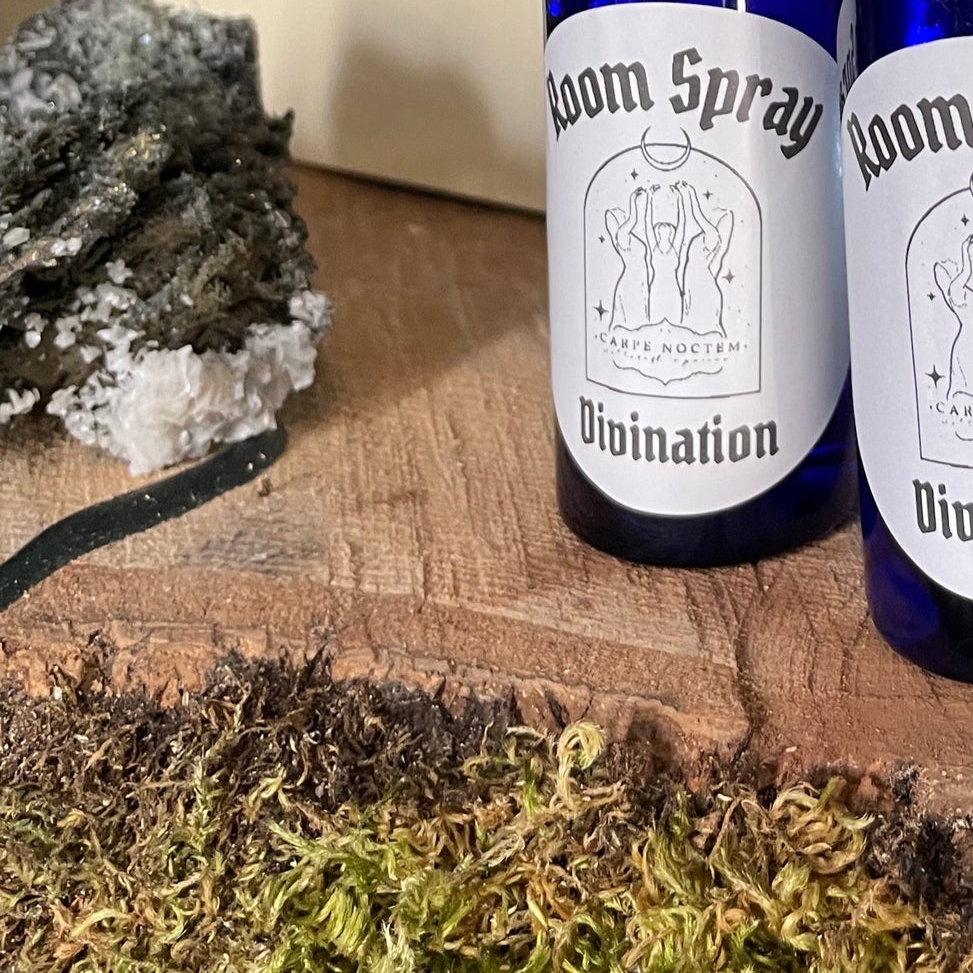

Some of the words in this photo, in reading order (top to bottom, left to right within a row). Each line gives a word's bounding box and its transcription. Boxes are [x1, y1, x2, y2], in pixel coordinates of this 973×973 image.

[546, 61, 655, 142] Room
[669, 47, 823, 159] Spray
[579, 395, 779, 466] Divination
